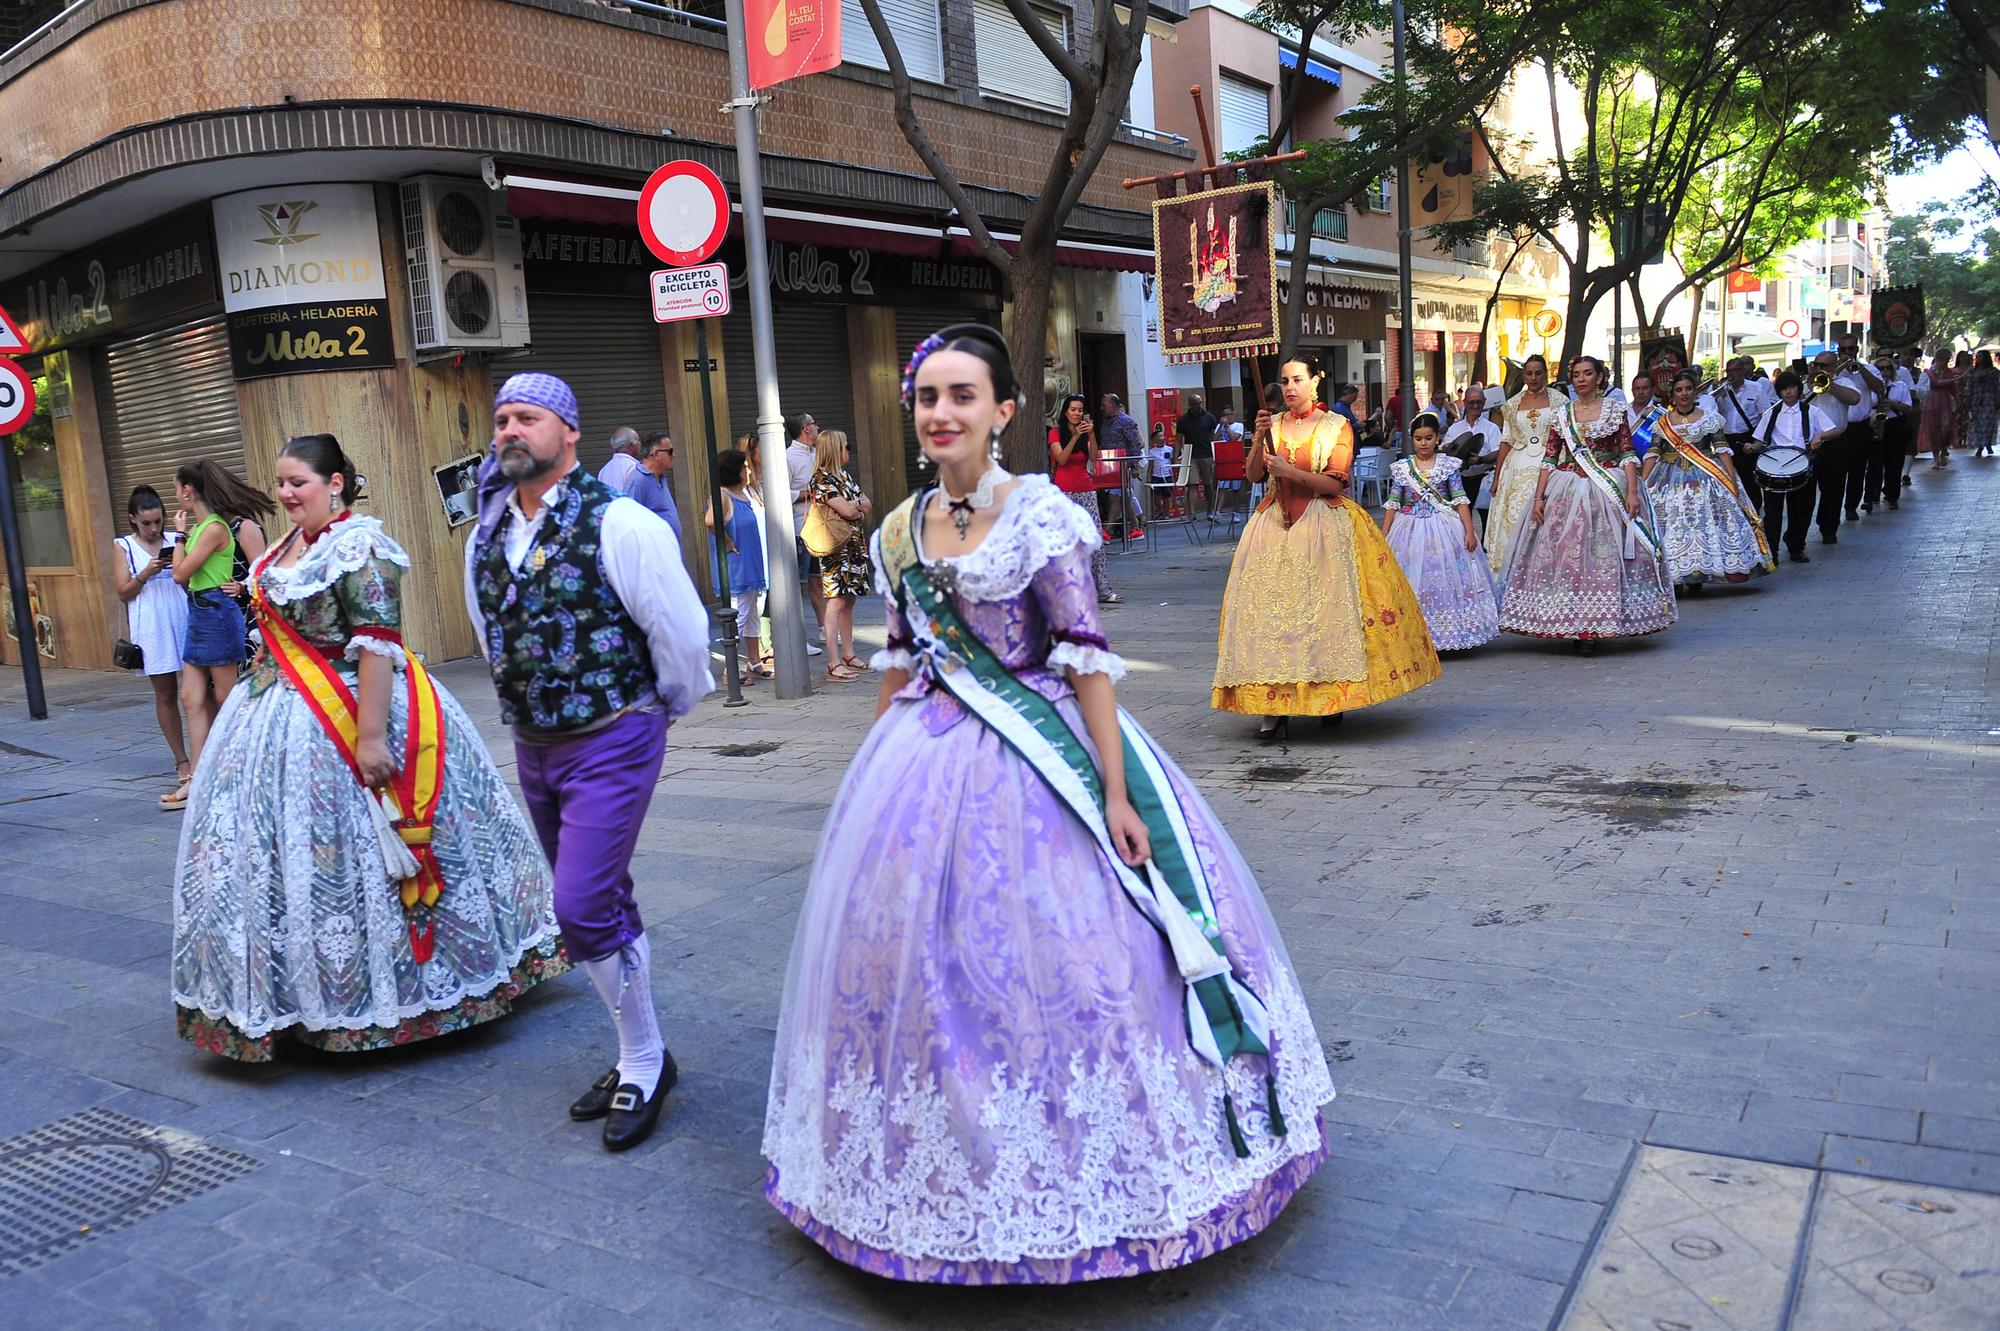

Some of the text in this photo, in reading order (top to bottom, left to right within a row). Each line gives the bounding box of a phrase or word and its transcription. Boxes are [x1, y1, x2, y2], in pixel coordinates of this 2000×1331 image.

[789, 4, 813, 17] AL TEU
[789, 13, 816, 26] COSTAT
[228, 257, 372, 294] DIAMOND
[665, 270, 711, 283] EXCEPTO
[850, 248, 874, 295] 2
[911, 261, 993, 290] HELADERIA
[88, 259, 112, 325] 2
[118, 243, 203, 299] HELADERIA
[660, 279, 718, 294] BICICLETAS
[707, 295, 720, 306] 10
[300, 303, 378, 321] HELADERÍA
[246, 325, 369, 365] Mila 2
